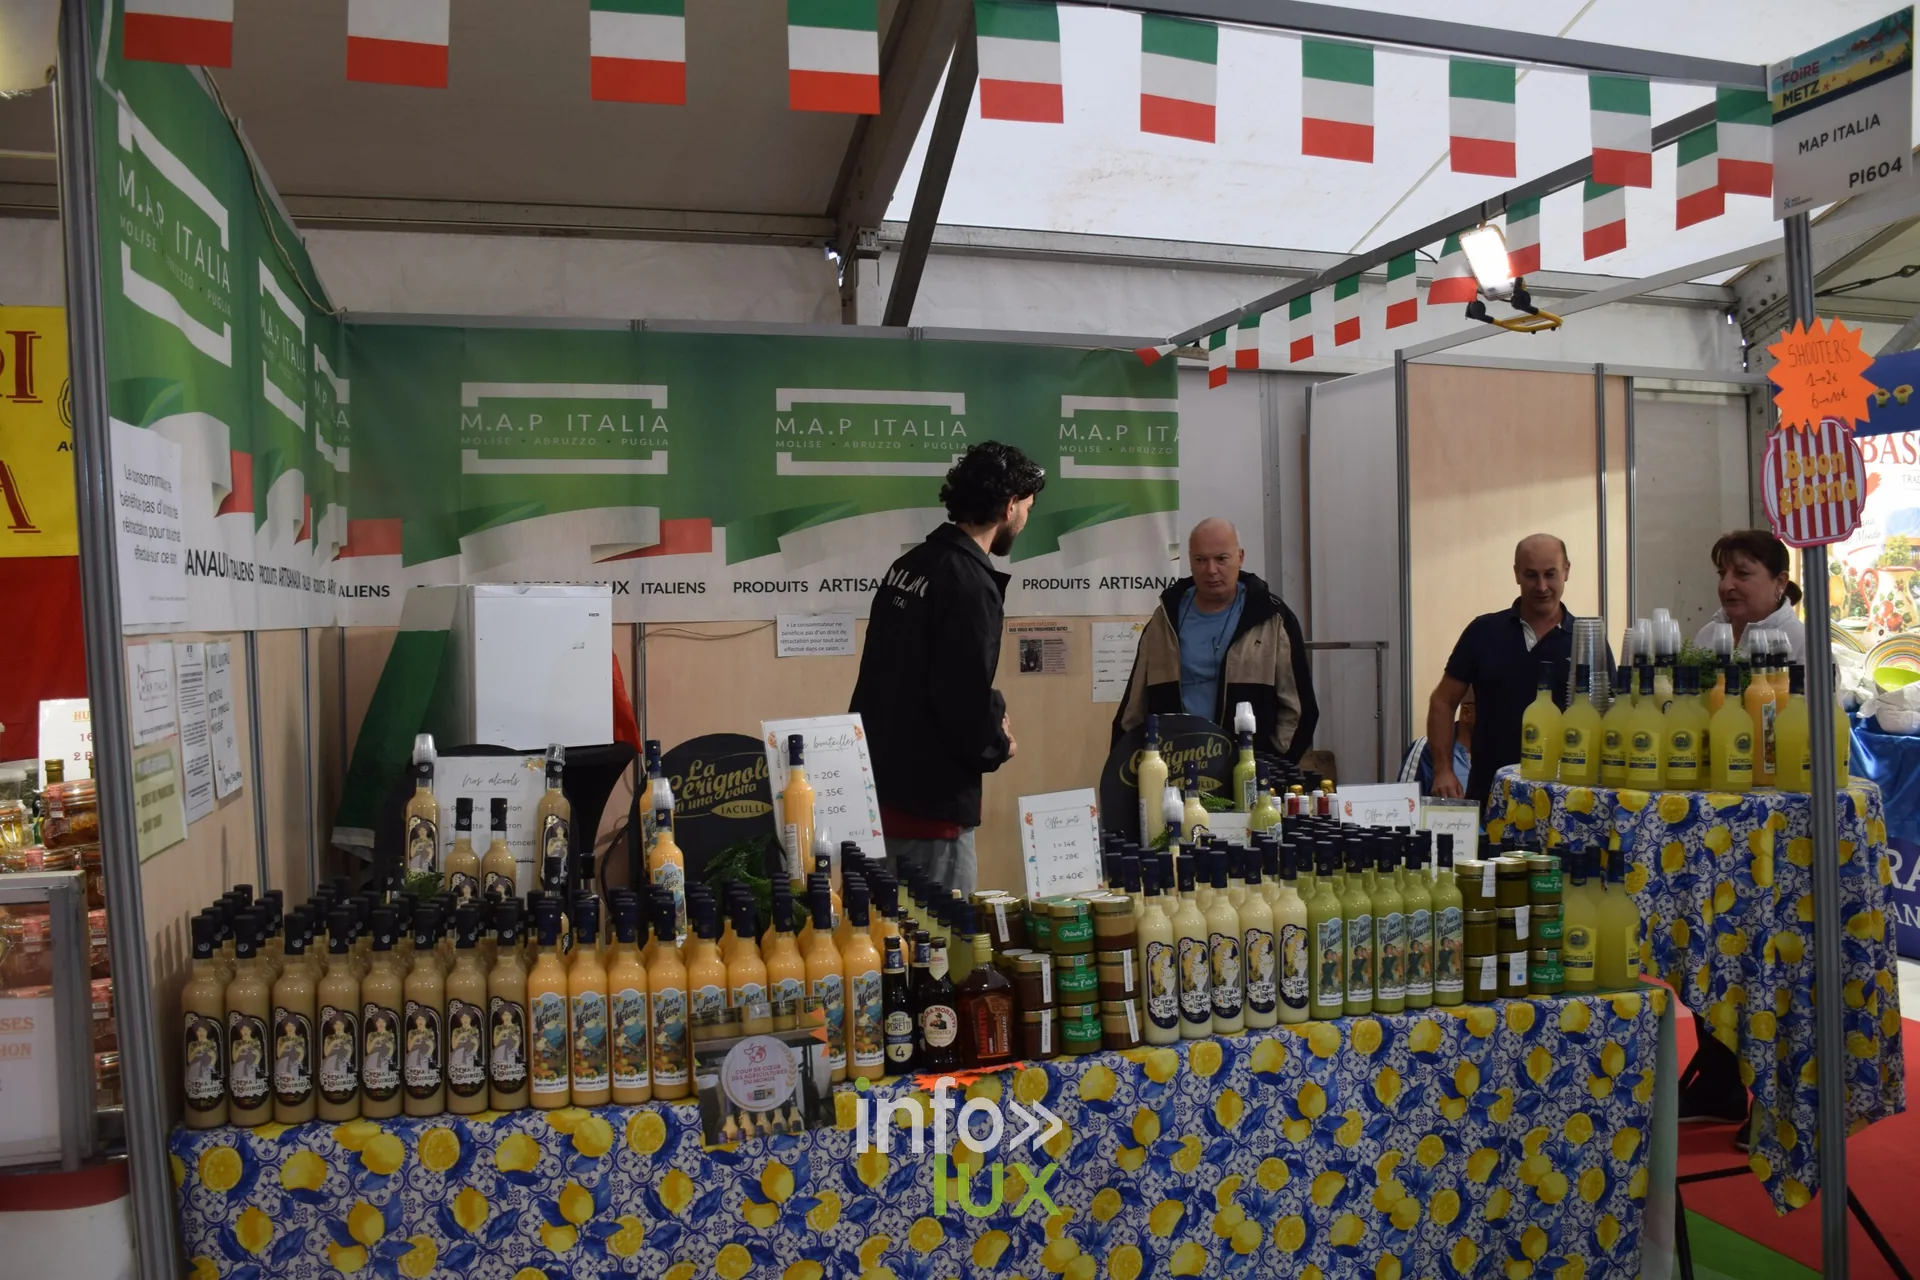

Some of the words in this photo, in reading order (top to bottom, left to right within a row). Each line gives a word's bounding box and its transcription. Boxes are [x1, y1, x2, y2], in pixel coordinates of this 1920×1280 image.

[1782, 80, 1820, 108] METZ
[1799, 132, 1829, 155] MAP
[1833, 113, 1880, 143] ITALIA
[177, 220, 230, 293] ITALIA
[1788, 339, 1851, 368] SHOOTERS
[460, 413, 543, 432] M.A.P
[567, 414, 669, 433] ITALIA
[775, 417, 852, 435] M.A.P
[874, 419, 967, 437] ITALIA
[1059, 424, 1128, 442] M.A.P
[460, 436, 511, 446] MOLISE
[534, 437, 596, 446] ABRUZZO
[621, 438, 669, 447] PUGLIA
[775, 440, 822, 449] MOLISE
[844, 441, 901, 450] ABRUZZO
[923, 441, 967, 450] PUGLIA
[1059, 445, 1101, 453] MOLISE
[1120, 446, 1173, 455] ABRUZZO
[1784, 450, 1847, 480] Buon
[1780, 478, 1857, 516] giorno
[149, 526, 165, 540] pour
[641, 582, 706, 595] ITALIENS
[733, 580, 808, 593] PRODUITS
[1022, 578, 1091, 590] PRODUITS
[814, 734, 856, 749] bouteilles
[686, 760, 716, 782] La
[822, 770, 841, 780] 20€
[488, 772, 521, 787] alcools
[688, 795, 713, 810] una
[725, 782, 757, 799] volta
[825, 787, 844, 797] 35€
[721, 804, 764, 815] IACULLI
[827, 805, 847, 815] 50€
[1044, 816, 1063, 829] Offre
[1051, 874, 1057, 882] 3
[1066, 871, 1084, 880] 40€
[887, 1020, 911, 1031] PORETTI
[895, 1046, 905, 1058] 4
[744, 1068, 788, 1079] AGRICULTURES
